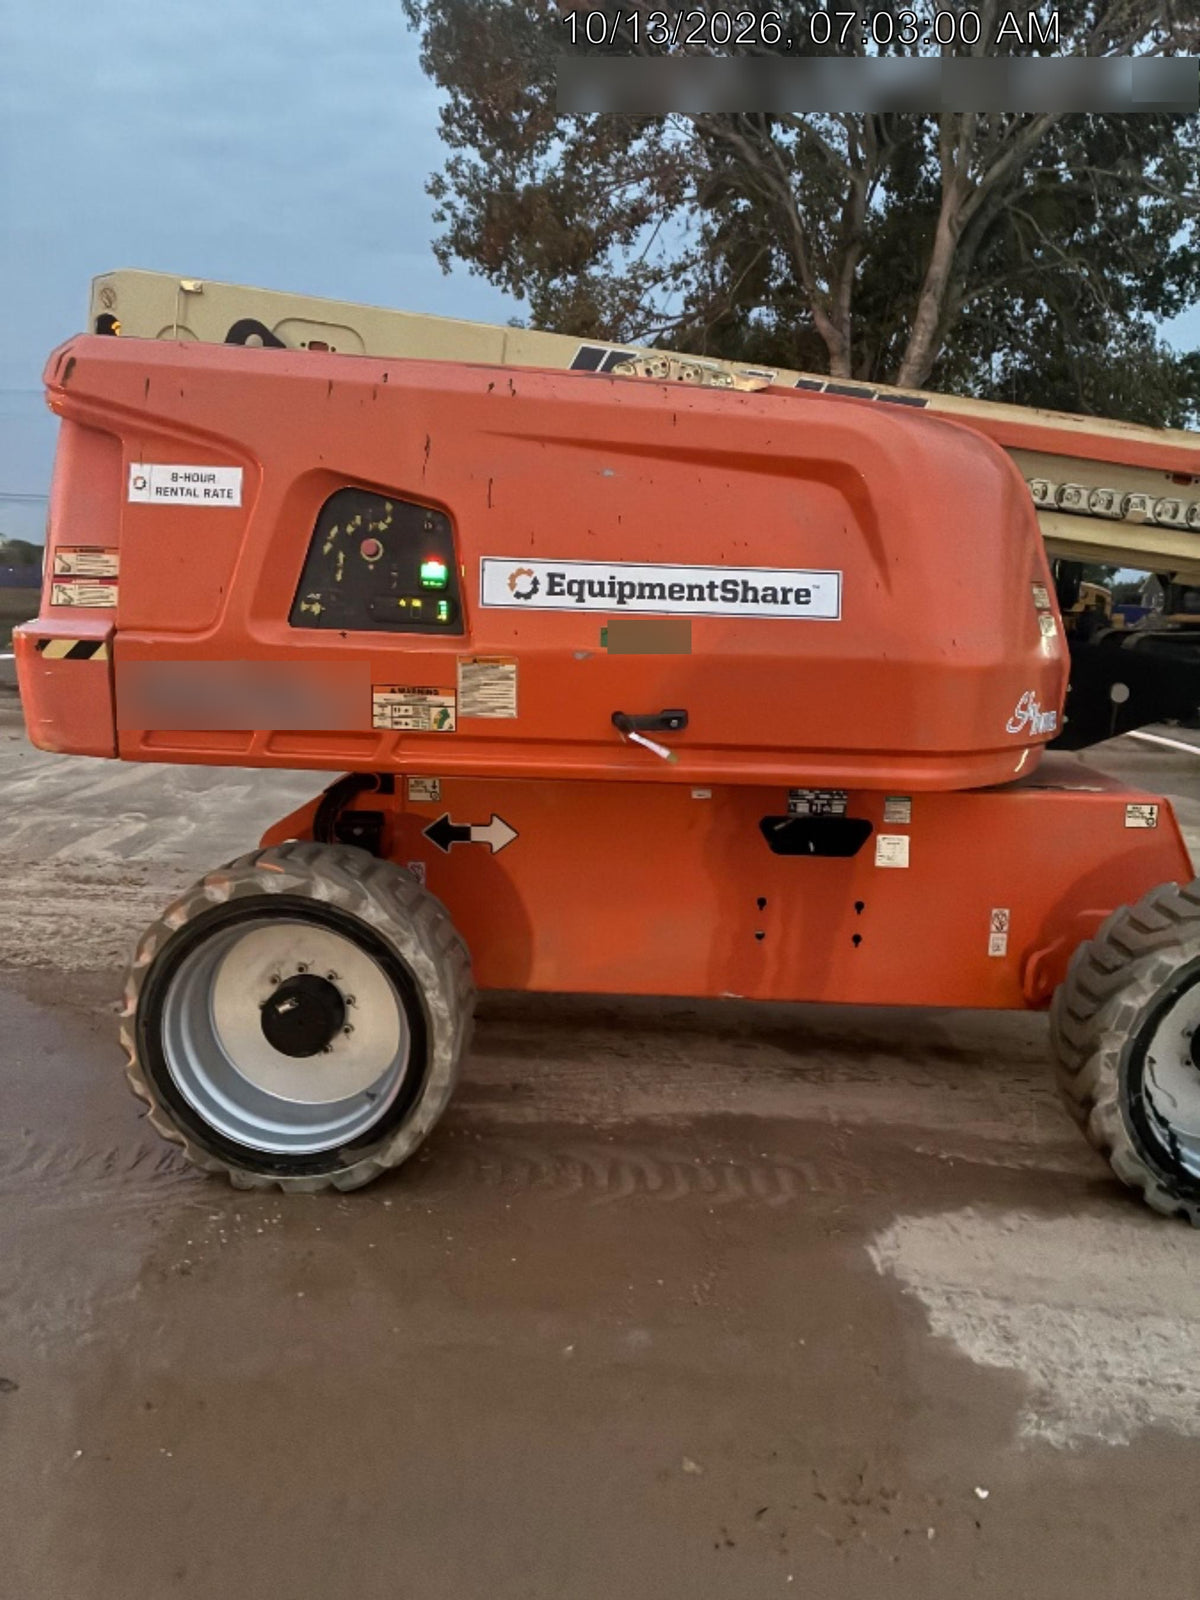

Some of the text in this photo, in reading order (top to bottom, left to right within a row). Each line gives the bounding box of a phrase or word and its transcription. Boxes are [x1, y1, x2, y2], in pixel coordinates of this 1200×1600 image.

[170, 472, 216, 484] 8-HOUR
[155, 486, 234, 499] RENTAL RATE
